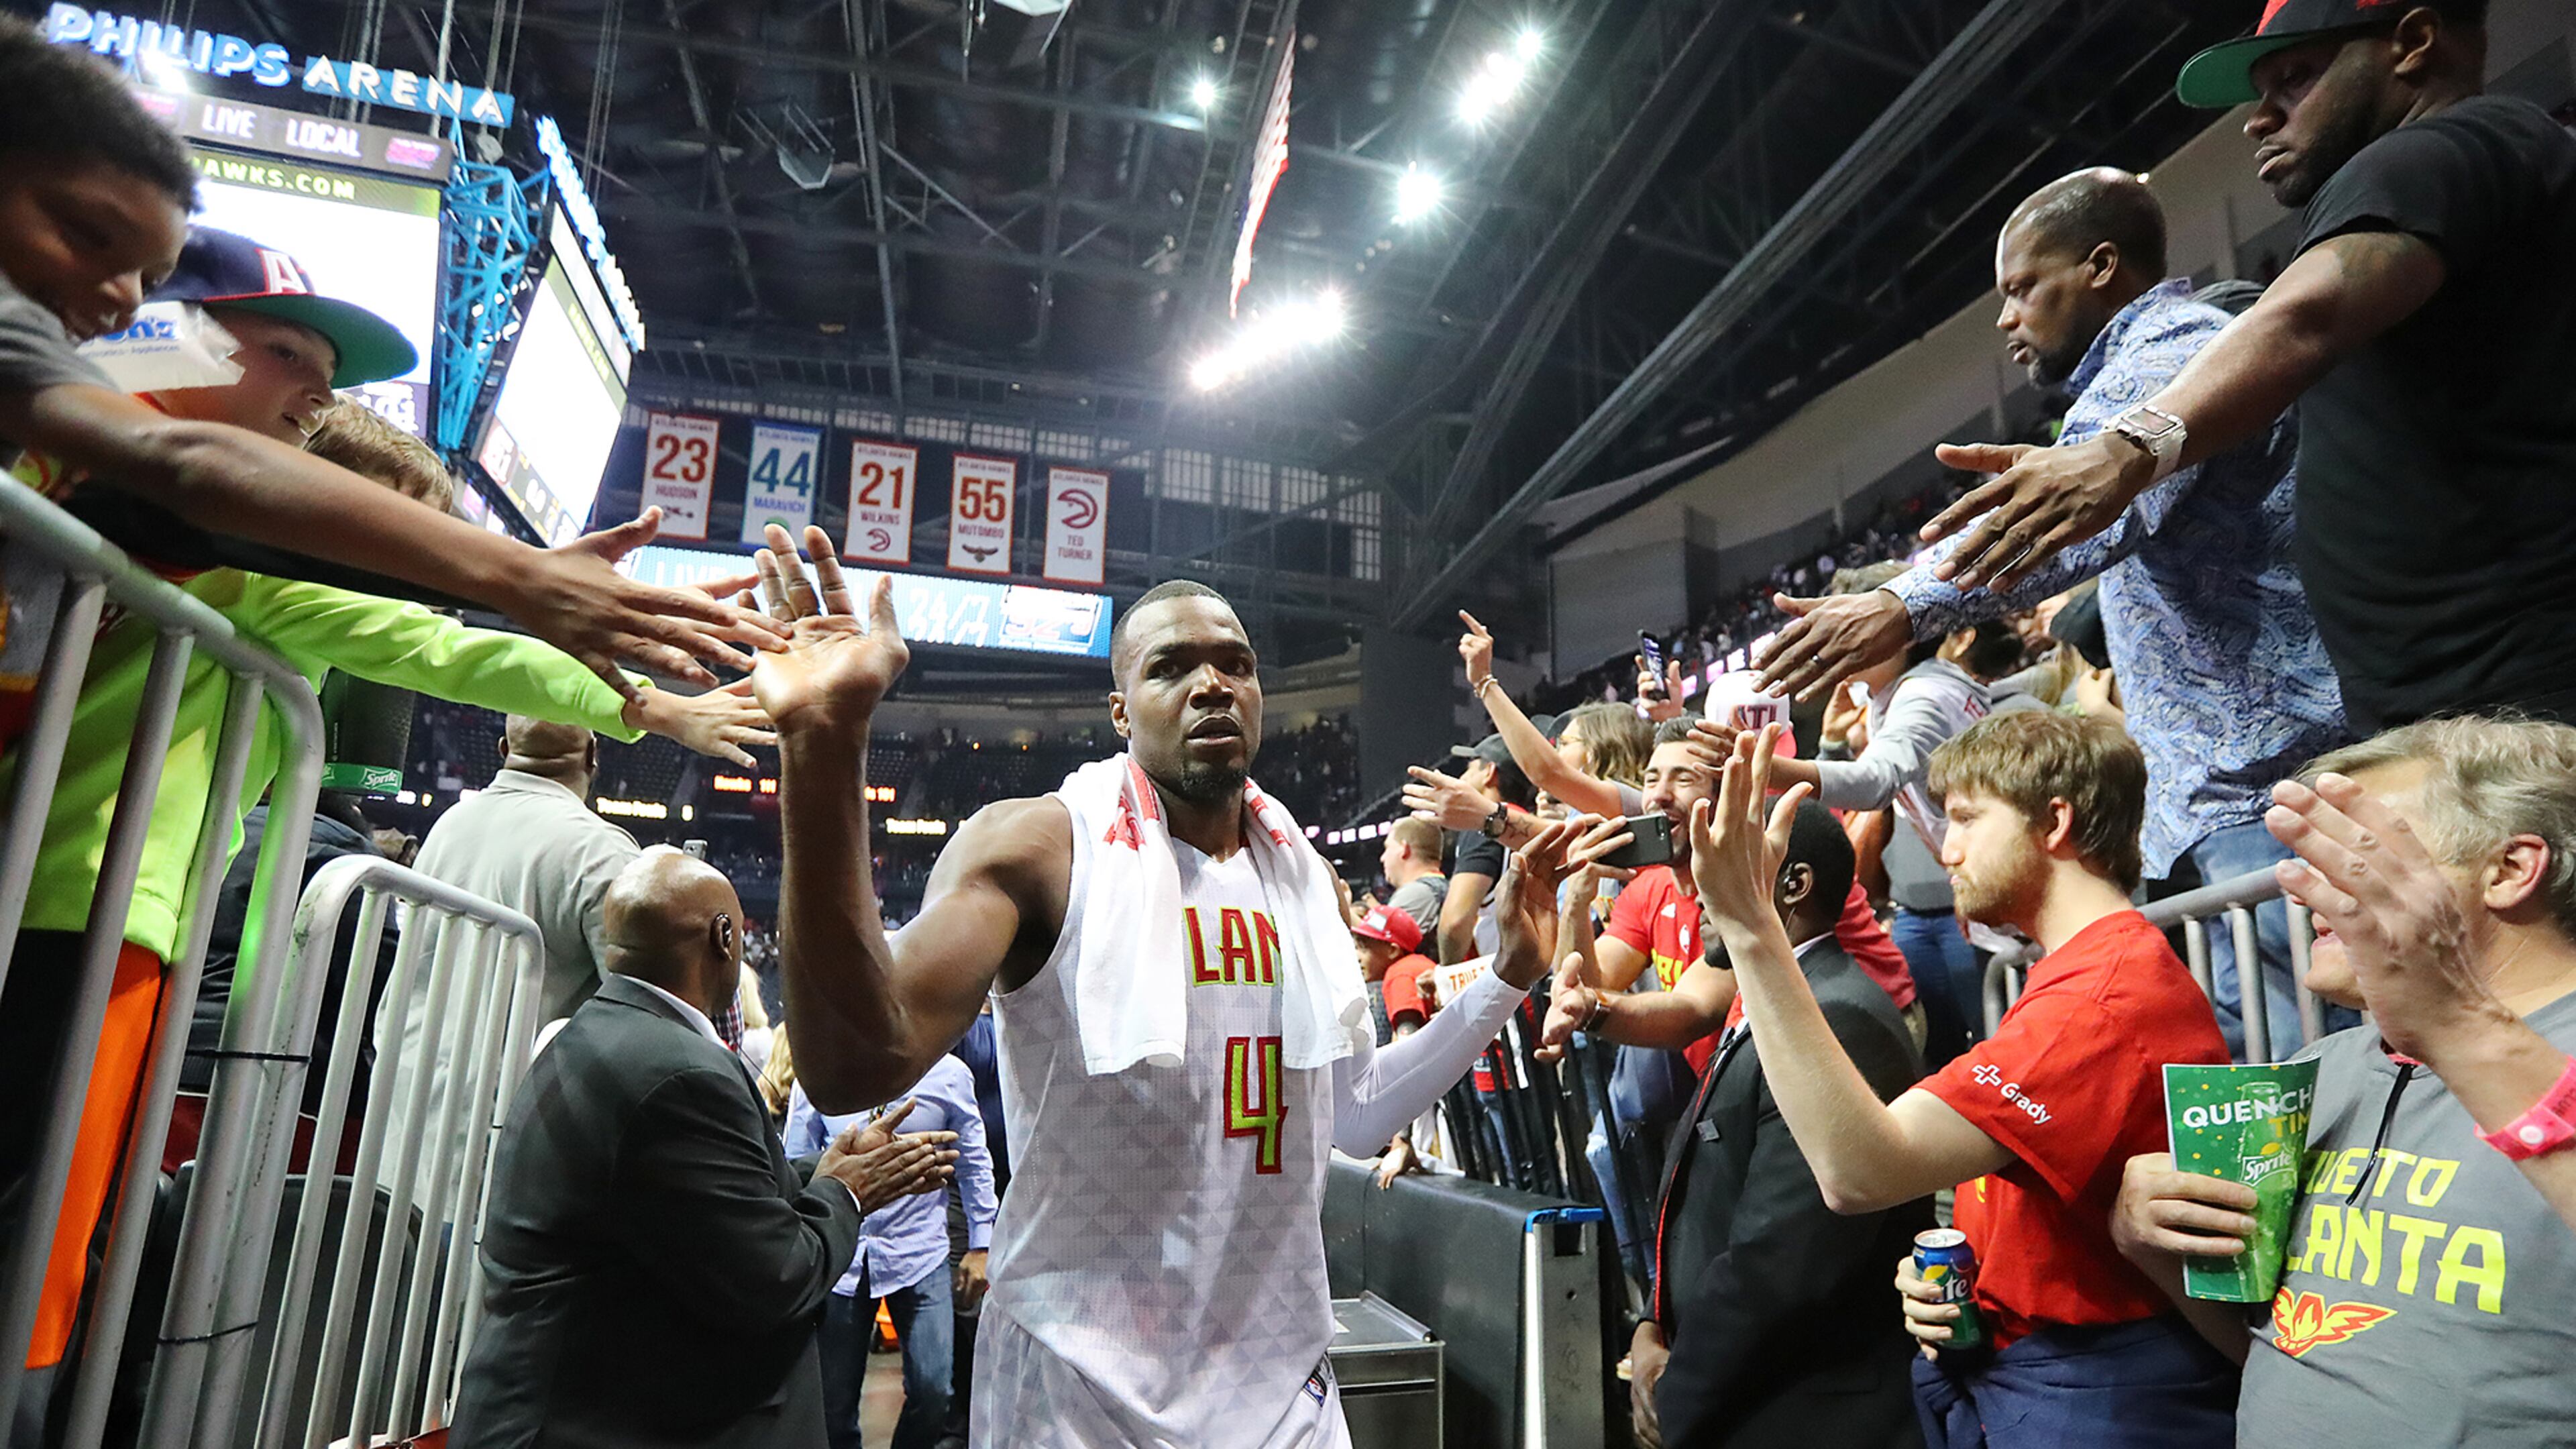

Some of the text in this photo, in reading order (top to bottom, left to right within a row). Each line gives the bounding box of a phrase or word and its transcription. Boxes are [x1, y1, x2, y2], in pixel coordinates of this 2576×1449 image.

[47, 1, 504, 124] PHILIPS ARENA
[202, 104, 257, 138] LIVE
[286, 117, 363, 158] LOCAL
[193, 157, 356, 200] AWKS.COM
[256, 248, 314, 294] A
[652, 433, 708, 483] 23
[752, 447, 811, 497] 44
[655, 484, 698, 499] HUDSON
[753, 495, 806, 513] MARAVICH
[857, 461, 905, 510] 21
[959, 476, 1006, 523] 55
[861, 511, 900, 525] WILKINS
[958, 523, 1005, 539] MUTOMBO
[1057, 546, 1093, 560] TURNER
[1067, 535, 1084, 547] TED
[1223, 1035, 1289, 1175] 4
[2000, 1082, 2053, 1125] Grady
[2183, 1083, 2314, 1128] QUENCH
[2268, 1110, 2311, 1138] TIM
[2244, 1150, 2292, 1181] Sprite
[2372, 1147, 2461, 1208] TO
